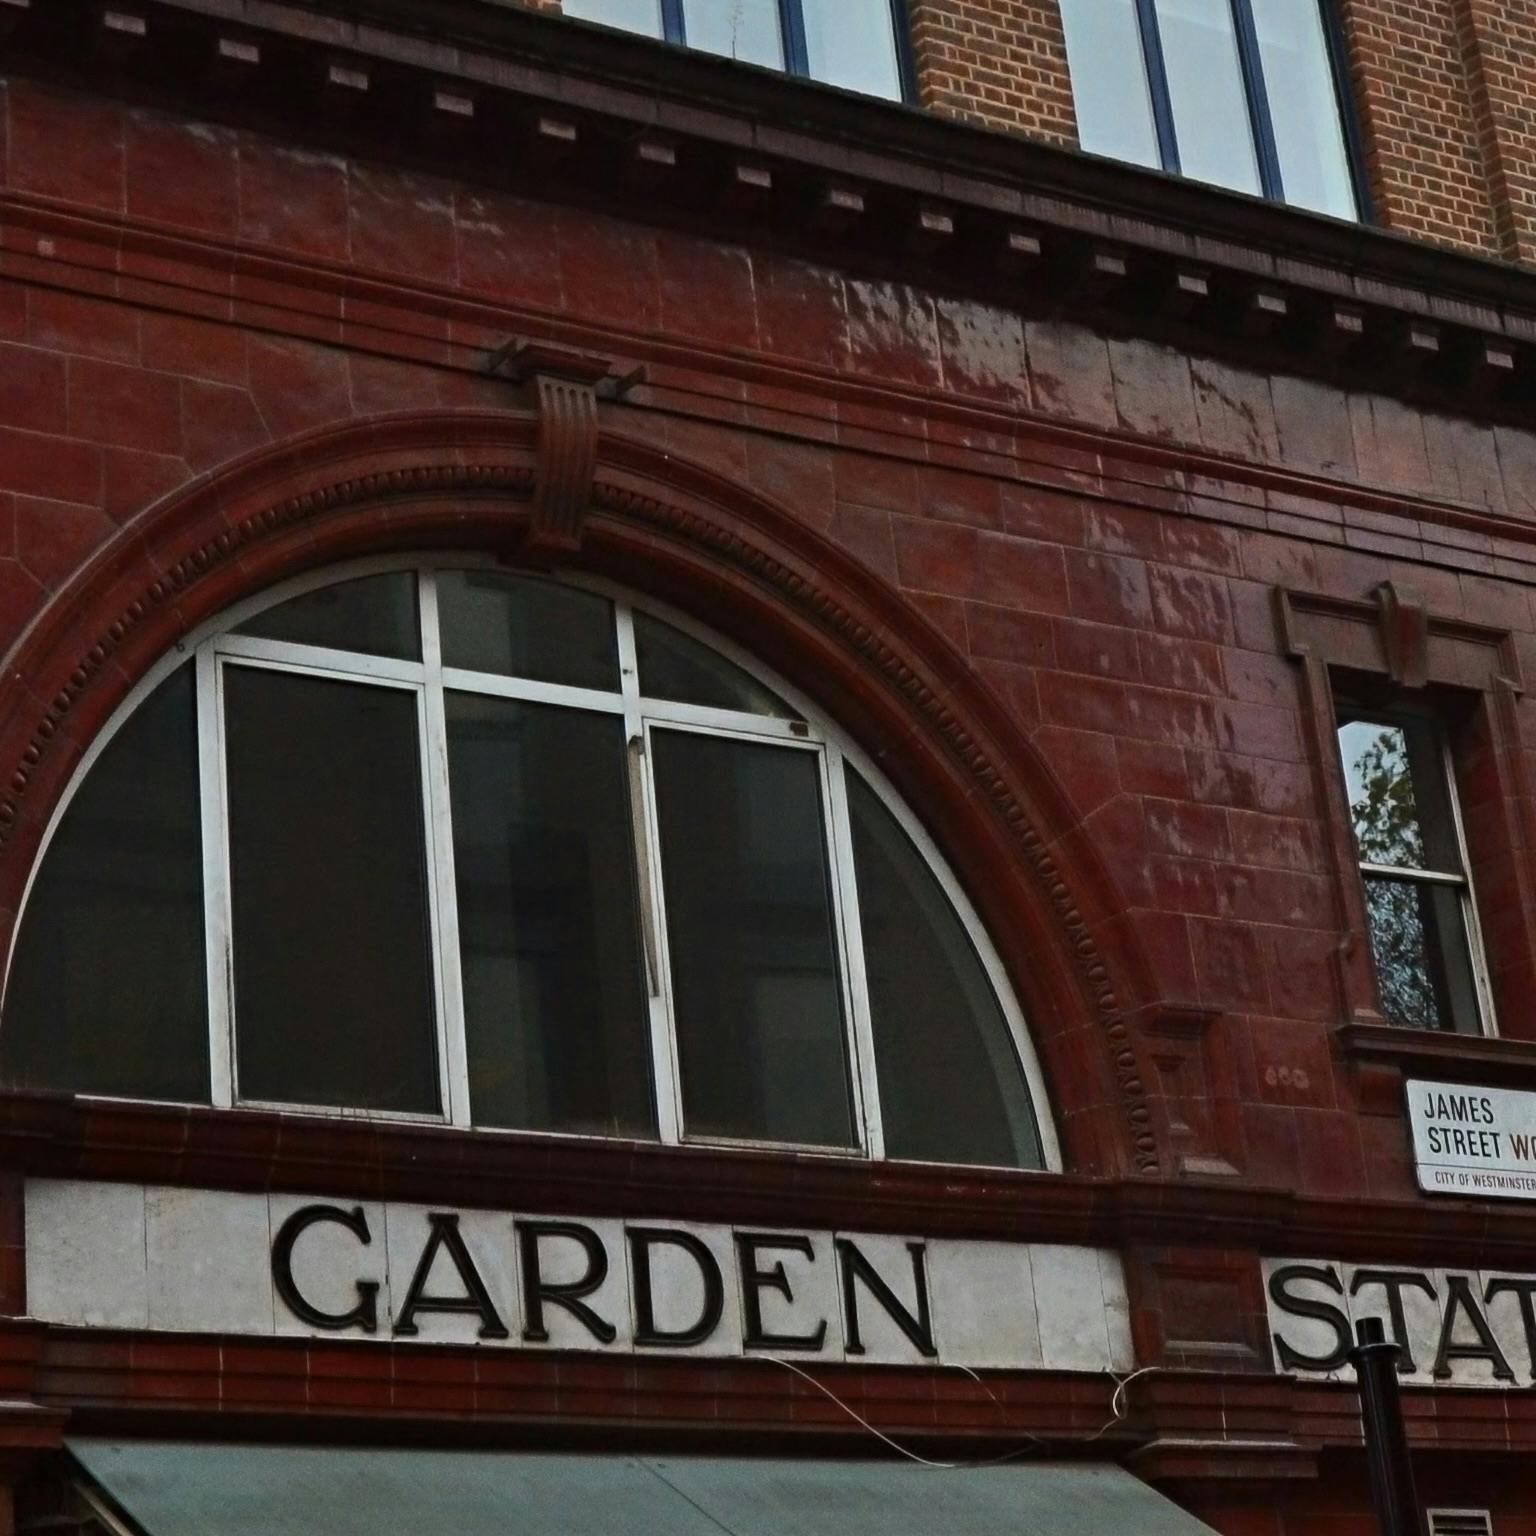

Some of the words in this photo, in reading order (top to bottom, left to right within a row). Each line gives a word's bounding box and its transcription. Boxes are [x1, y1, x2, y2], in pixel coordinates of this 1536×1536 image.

[1424, 1092, 1494, 1124] JAMES
[1427, 1126, 1501, 1159] STREET
[1435, 1171, 1455, 1185] CITY
[1459, 1174, 1469, 1186] OF
[270, 1203, 940, 1357] GARDEN
